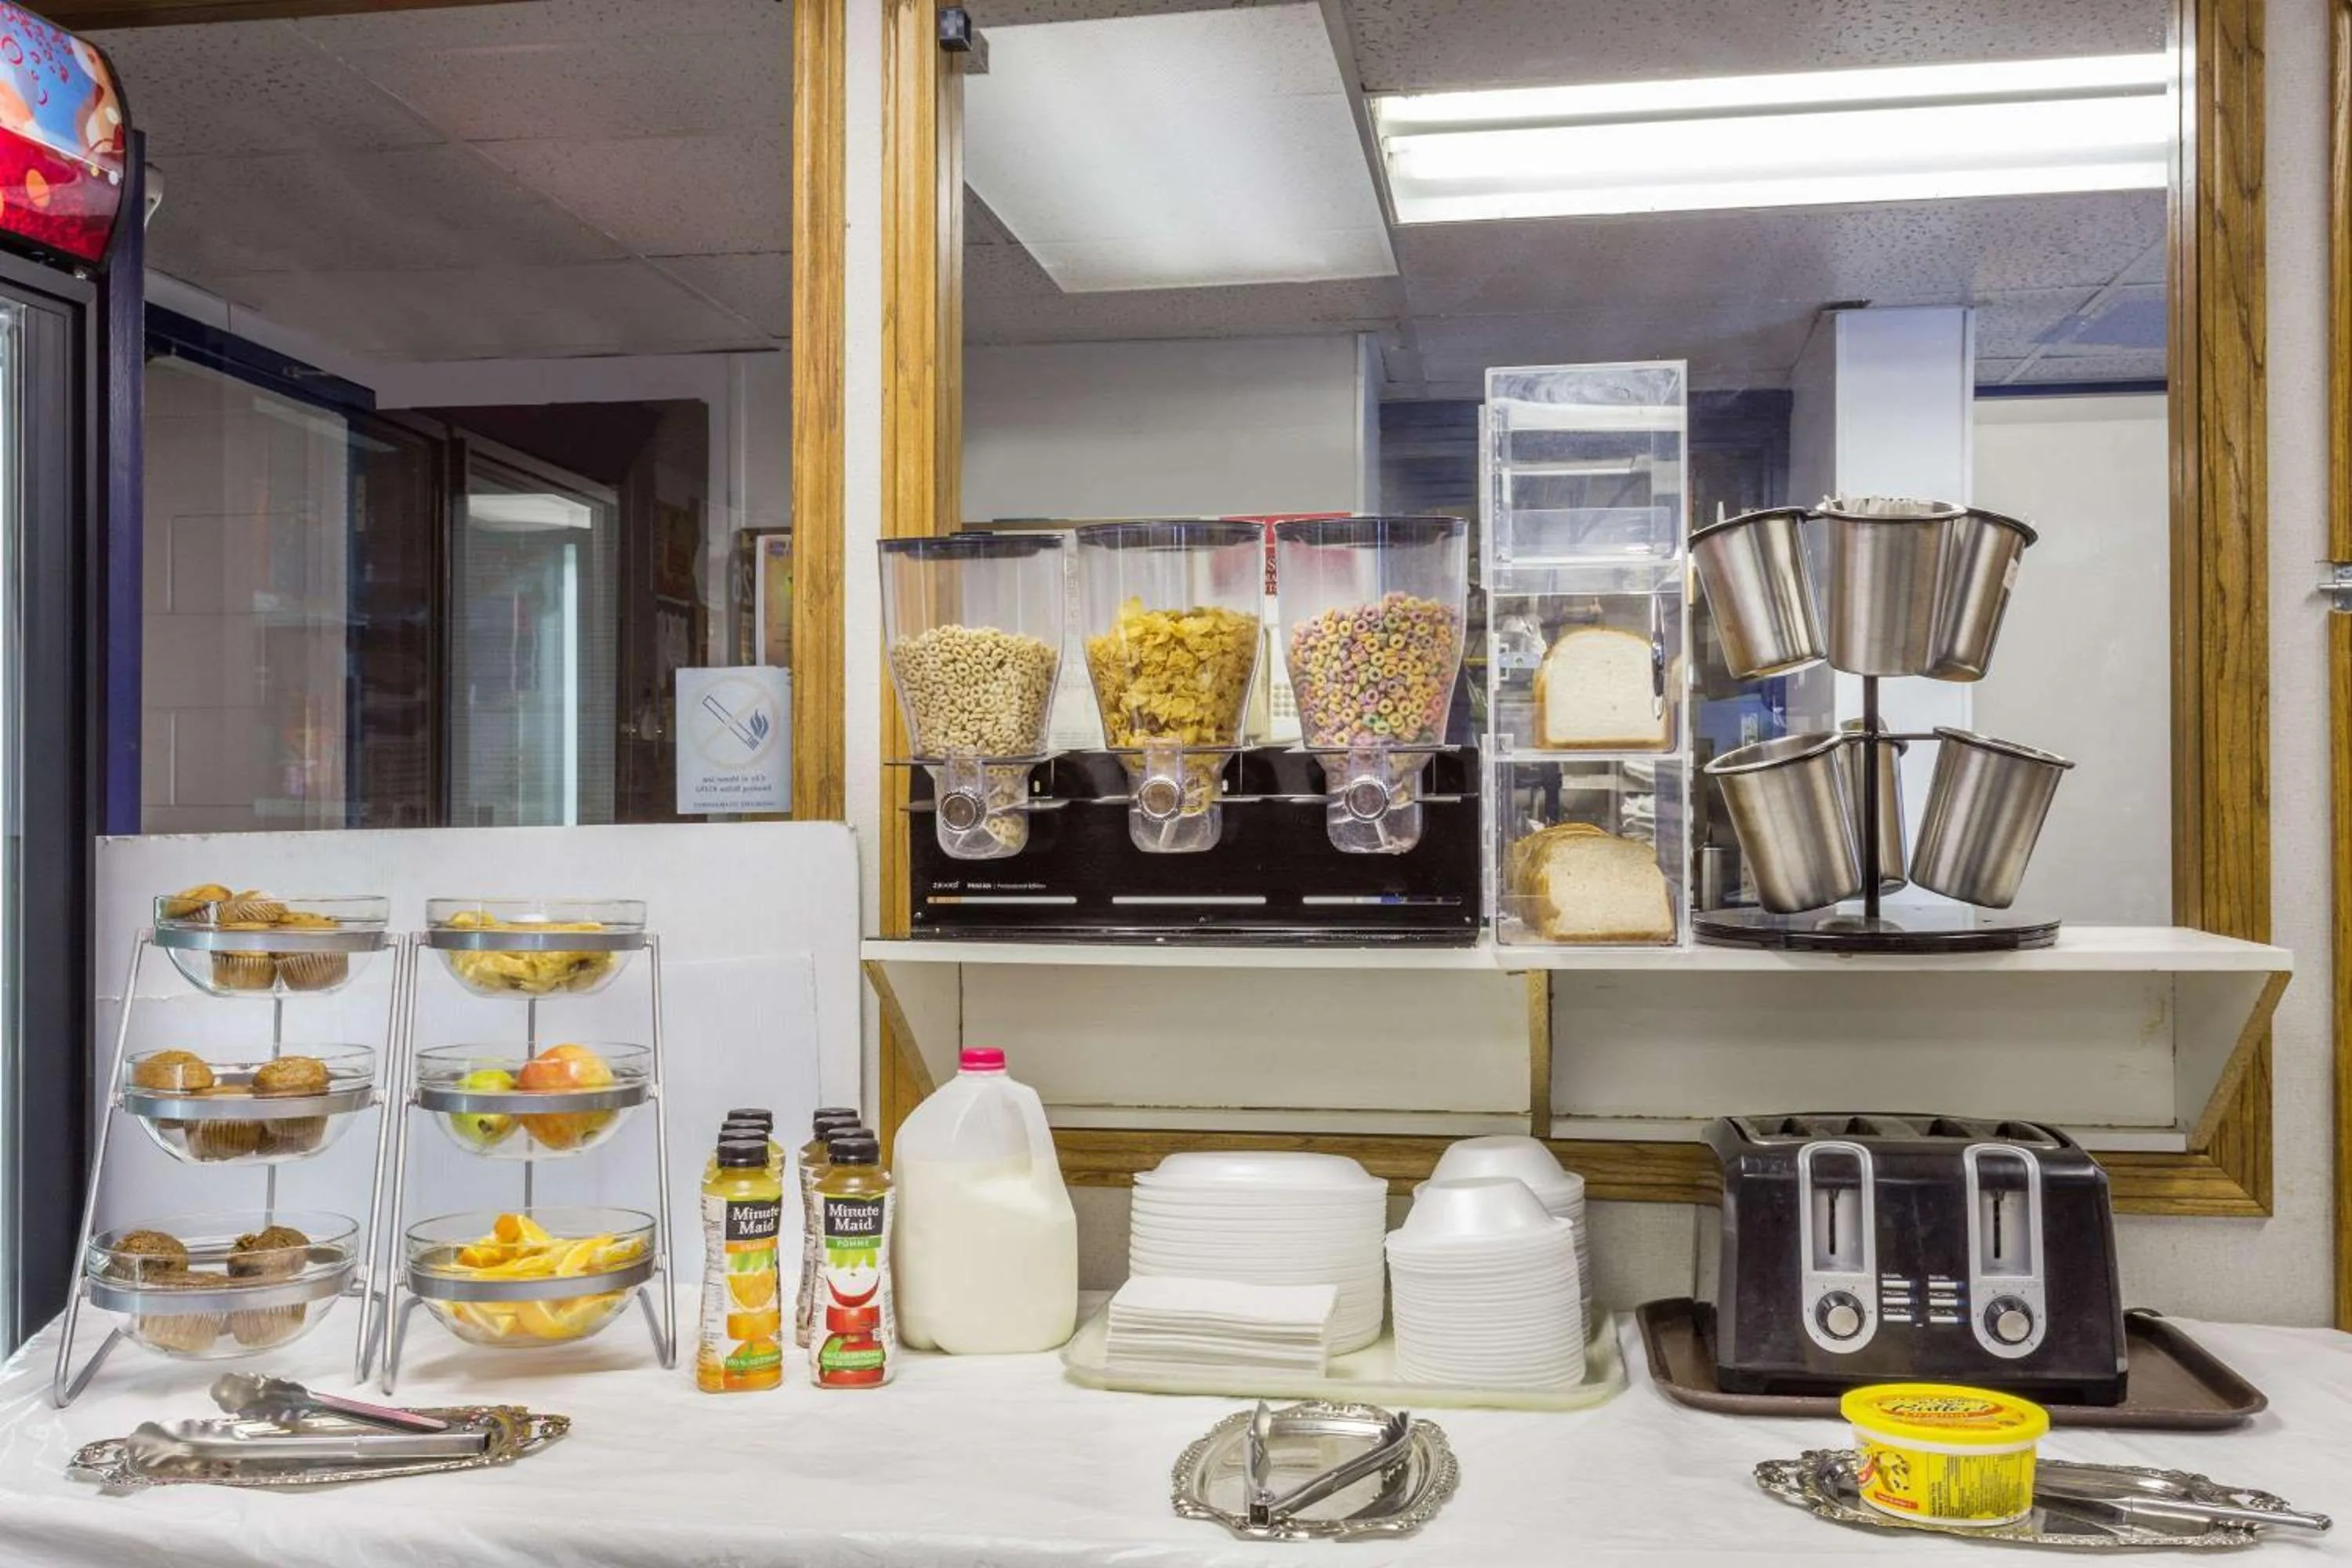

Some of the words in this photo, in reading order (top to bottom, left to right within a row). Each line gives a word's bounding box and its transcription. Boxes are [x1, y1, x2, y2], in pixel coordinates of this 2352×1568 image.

[732, 1205, 780, 1221] Minute
[828, 1203, 879, 1217] Minute
[738, 1218, 775, 1235] Maid
[834, 1218, 873, 1231] Maid
